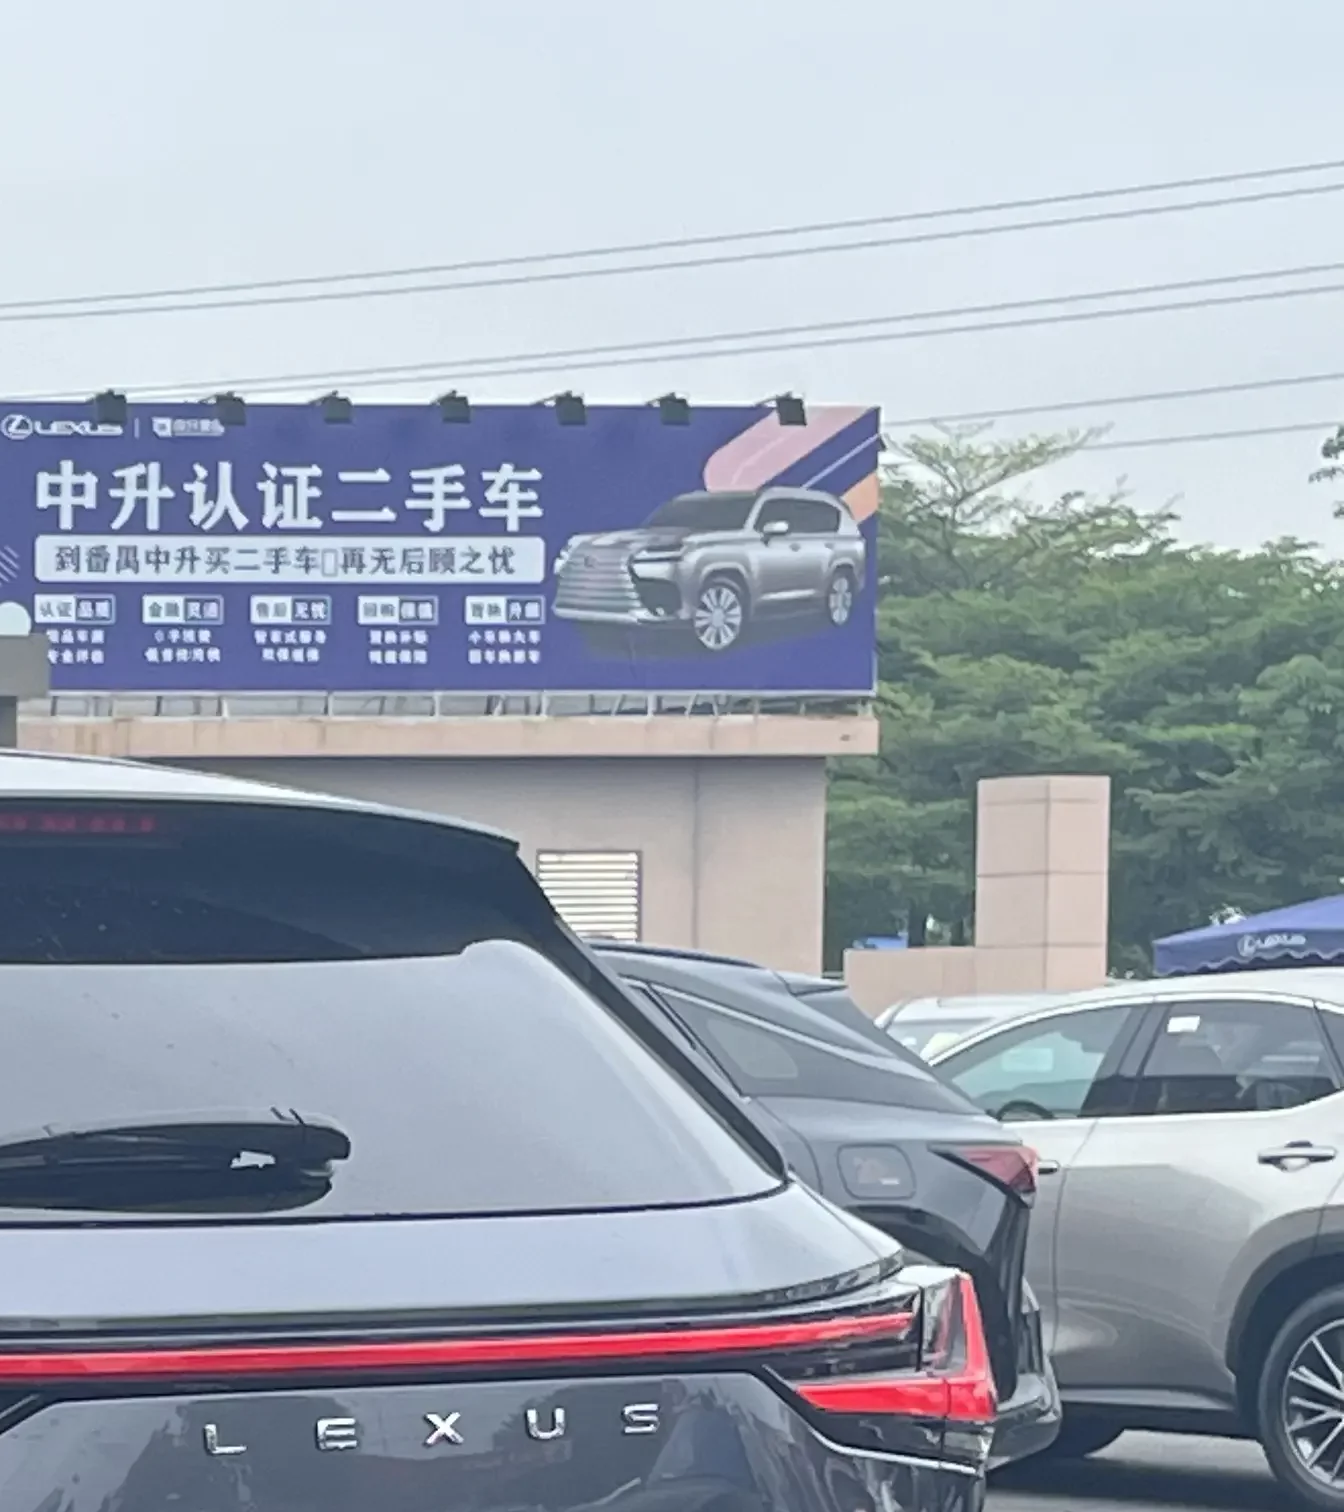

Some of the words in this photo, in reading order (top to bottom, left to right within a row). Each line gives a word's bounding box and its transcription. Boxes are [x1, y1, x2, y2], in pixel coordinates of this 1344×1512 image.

[35, 459, 544, 531] 中升认证二手车
[203, 1402, 660, 1455] LEXUS
